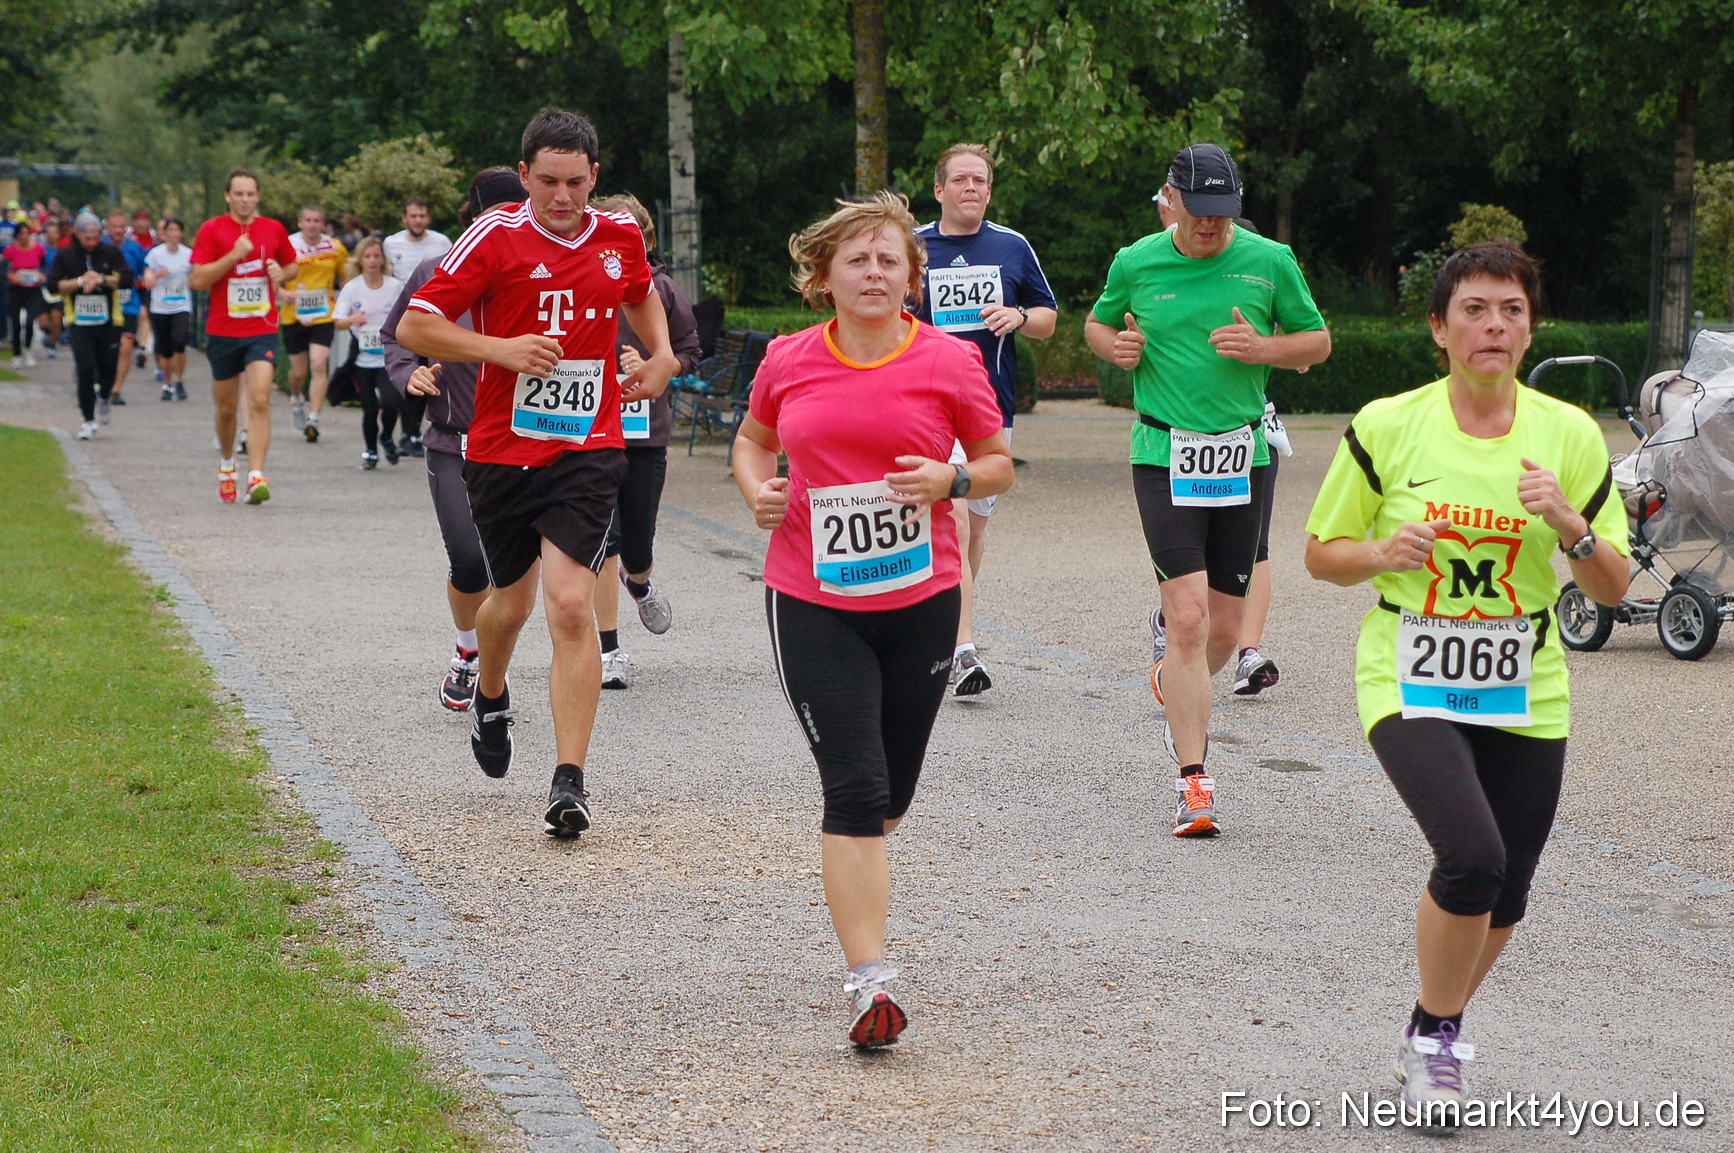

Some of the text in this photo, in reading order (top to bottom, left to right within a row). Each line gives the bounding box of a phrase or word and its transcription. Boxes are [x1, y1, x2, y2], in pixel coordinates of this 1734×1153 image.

[237, 287, 262, 302] 209
[938, 281, 996, 308] 2542
[553, 368, 592, 377] Neumarkt
[523, 377, 595, 412] 2348
[536, 417, 581, 433] Markus
[1179, 444, 1247, 474] 3020
[1191, 483, 1233, 495] Andreas
[813, 497, 848, 509] PARTL
[824, 504, 920, 555] 2058
[1423, 501, 1528, 533] Müller
[840, 556, 912, 583] Elisabeth
[1447, 558, 1501, 598] M
[1402, 615, 1511, 631] PARTL Neumarkt
[1410, 634, 1520, 681] 2068
[1446, 693, 1479, 710] Rita
